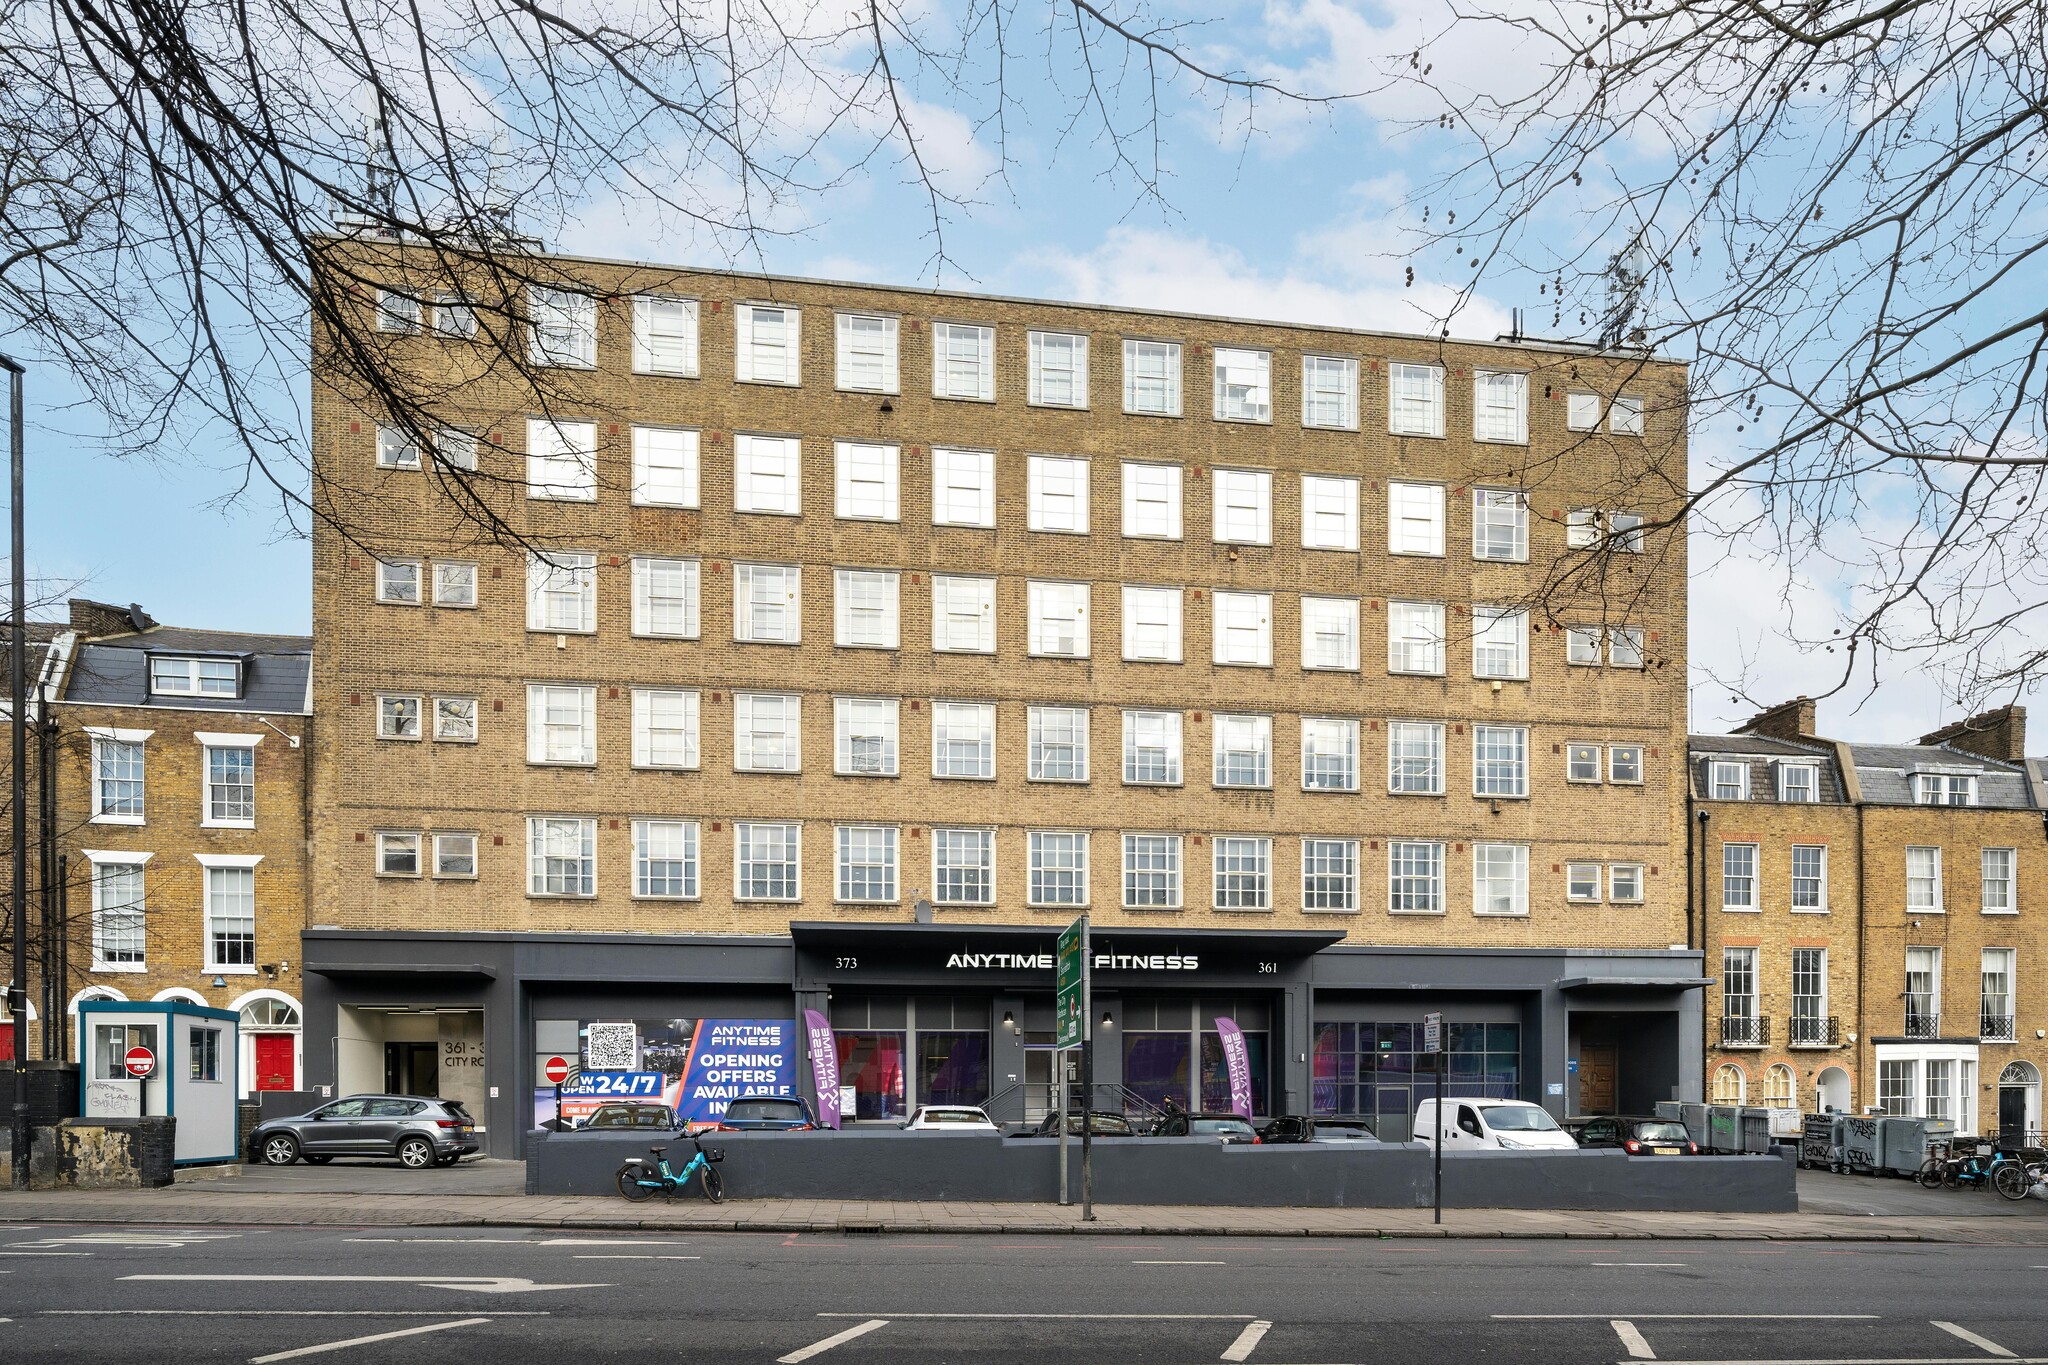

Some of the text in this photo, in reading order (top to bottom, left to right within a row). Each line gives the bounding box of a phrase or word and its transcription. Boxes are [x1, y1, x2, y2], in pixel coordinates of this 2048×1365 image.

[835, 957, 857, 969] 373
[946, 954, 1198, 969] ANYTIME FITNESS
[1258, 962, 1277, 973] 361
[712, 1026, 781, 1036] ANYTIME
[711, 1036, 781, 1046] FITNESS
[445, 1042, 466, 1054] 361
[445, 1057, 468, 1067] CITY
[700, 1054, 783, 1067] OPENING
[706, 1070, 777, 1083] OFFERS
[595, 1076, 656, 1094] 24/7
